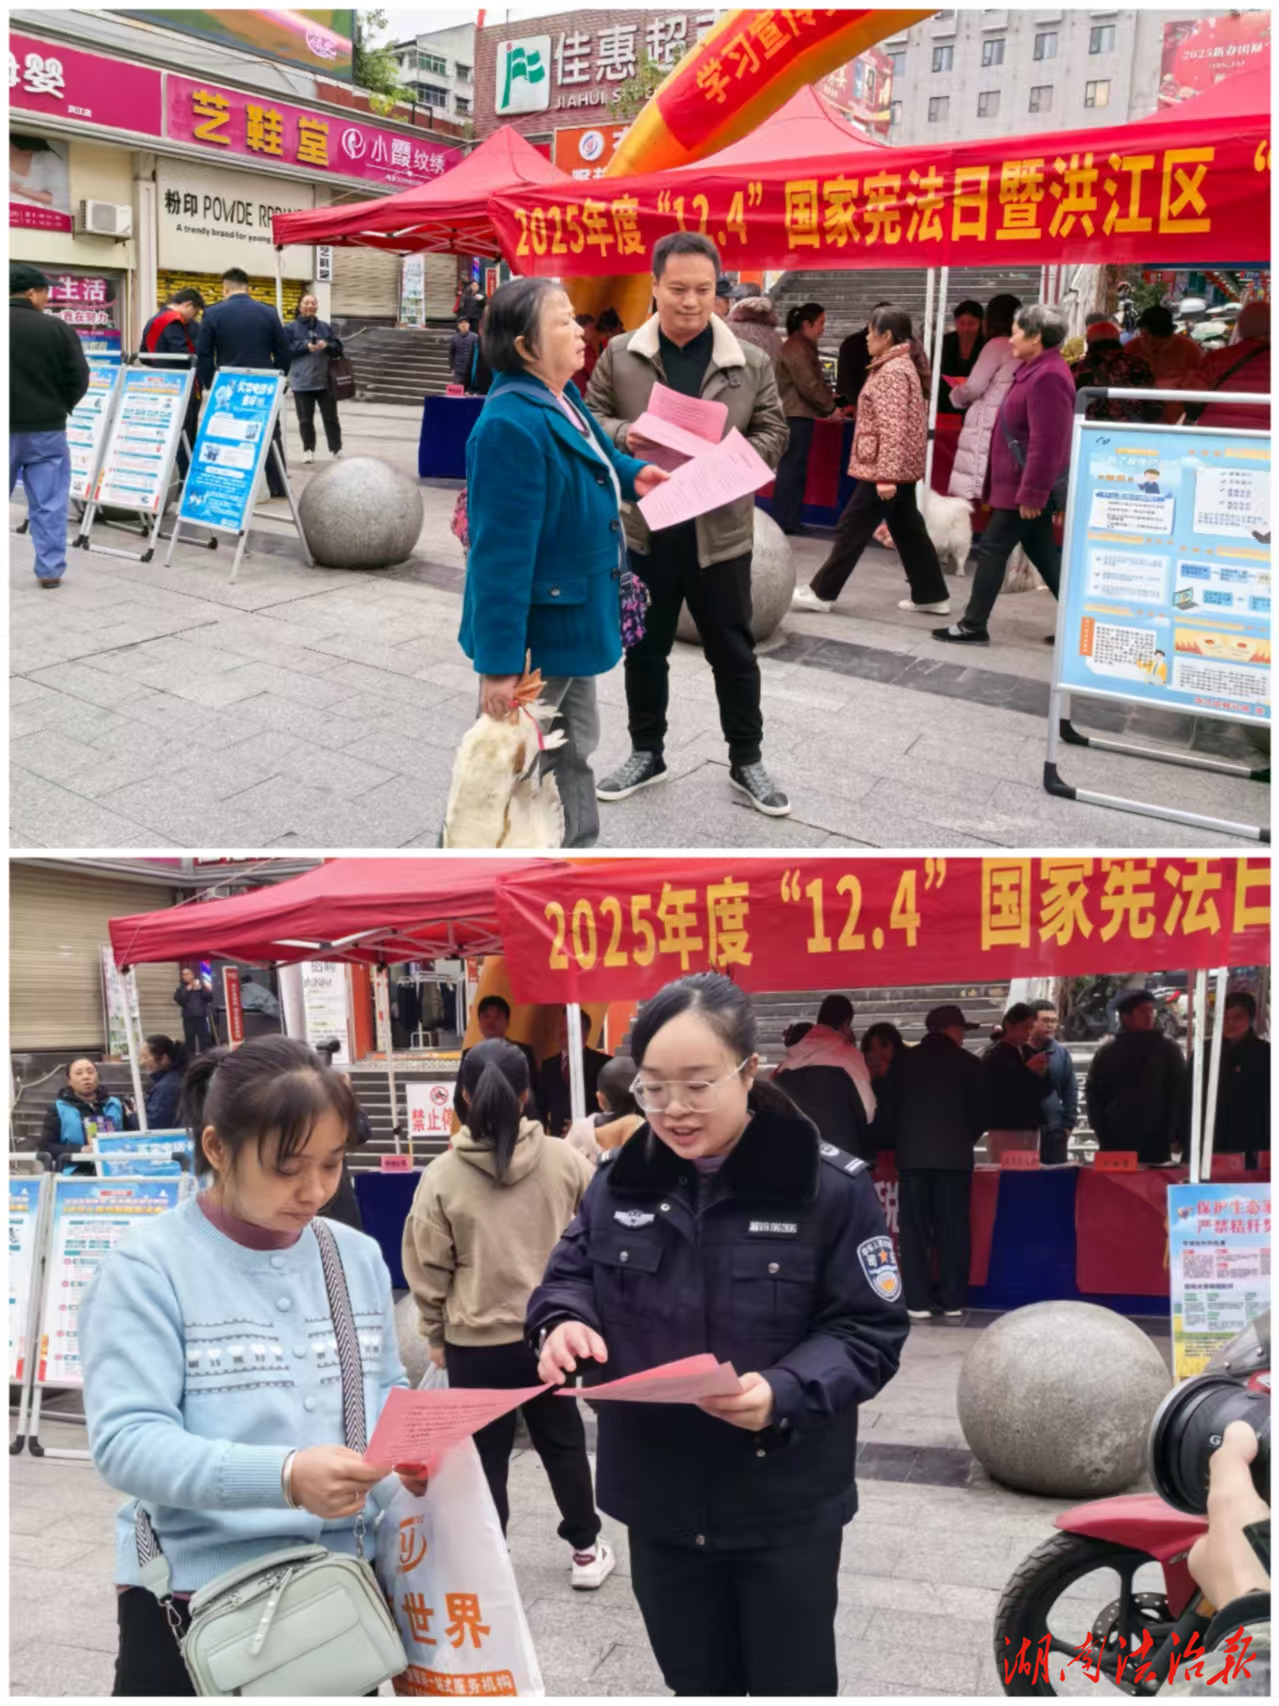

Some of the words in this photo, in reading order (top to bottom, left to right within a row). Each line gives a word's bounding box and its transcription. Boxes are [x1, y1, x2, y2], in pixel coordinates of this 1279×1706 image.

[694, 10, 834, 104] 学习宣传
[557, 88, 607, 110] JIAHUI
[192, 90, 329, 167] 艺鞋堂
[371, 135, 445, 174] 小霞纹绣
[165, 189, 198, 218] 粉印
[203, 195, 253, 227] POWDE
[211, 228, 235, 239] brand
[235, 232, 247, 240] for
